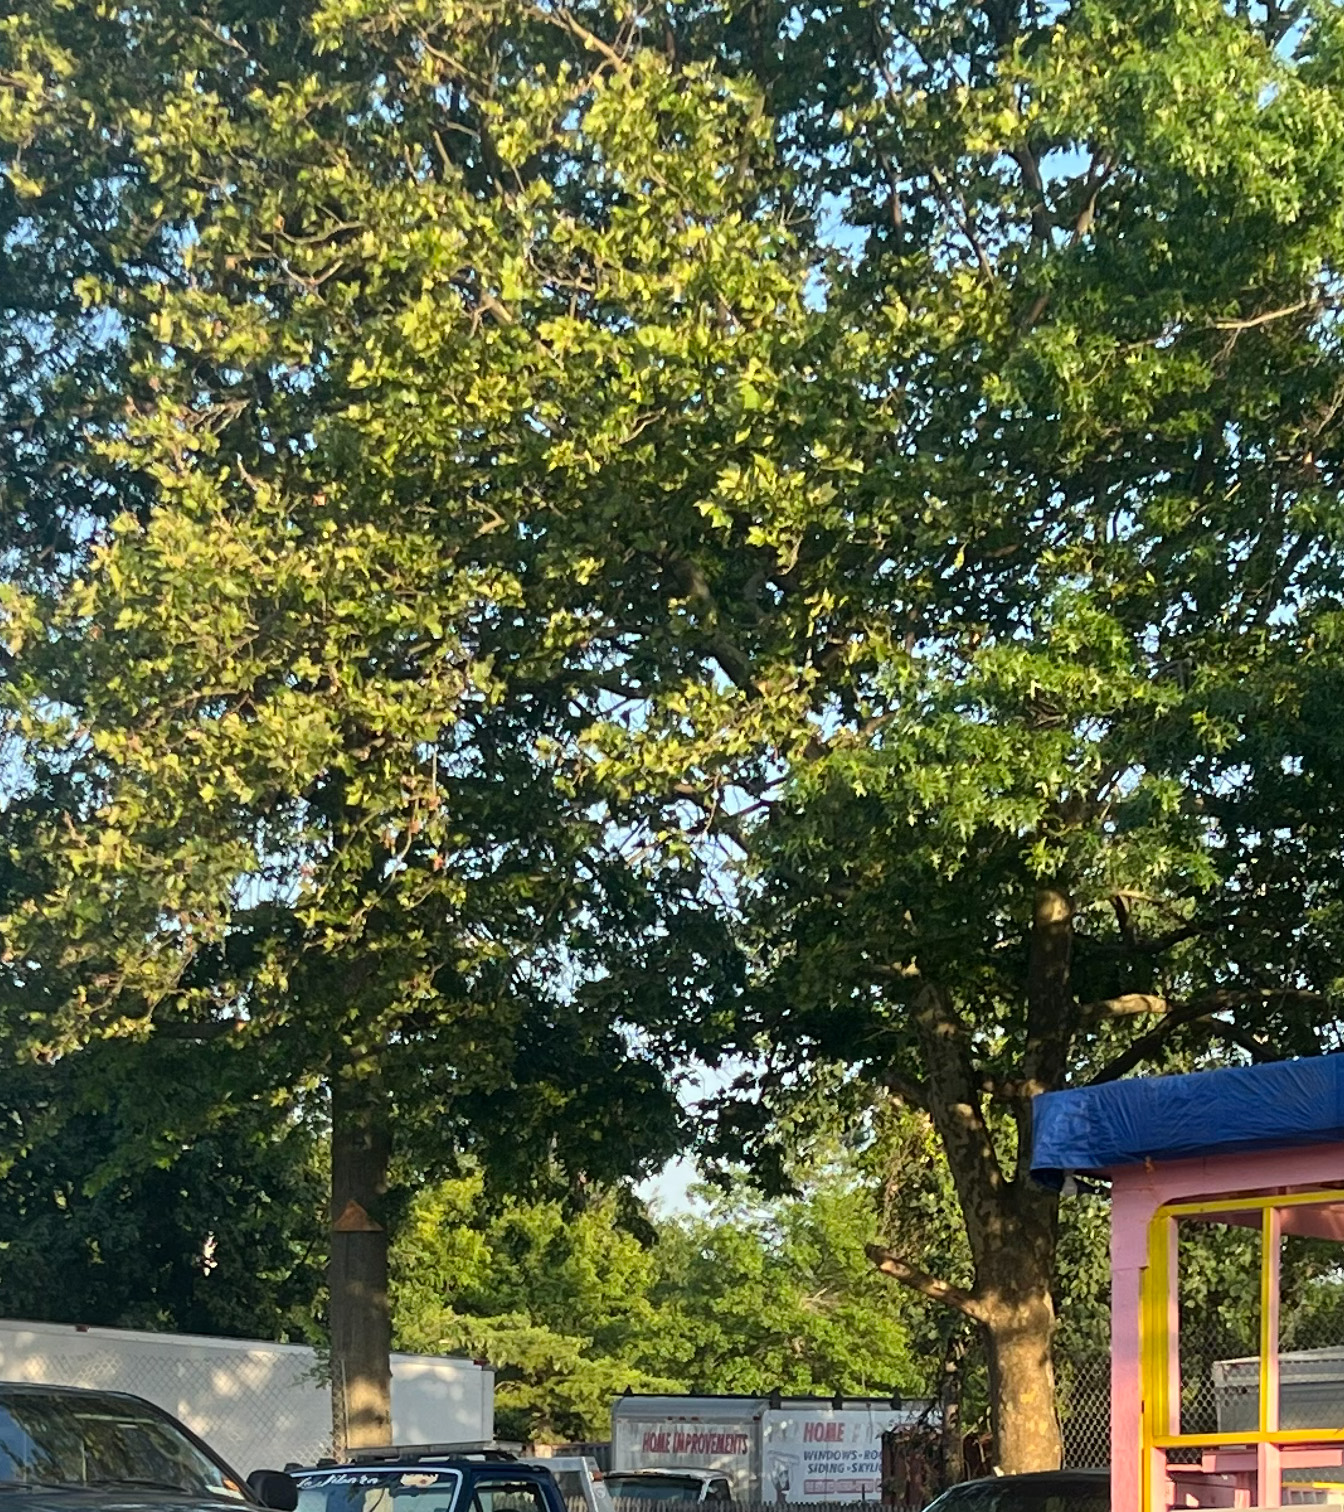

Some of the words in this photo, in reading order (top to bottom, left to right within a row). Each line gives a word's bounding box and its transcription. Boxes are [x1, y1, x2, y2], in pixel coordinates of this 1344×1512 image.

[802, 1422, 846, 1443] HOME
[642, 1432, 672, 1453] HOME
[673, 1432, 748, 1455] IMPROVEMENTS
[803, 1450, 858, 1461] WINDOWS
[807, 1463, 845, 1474] SIDING
